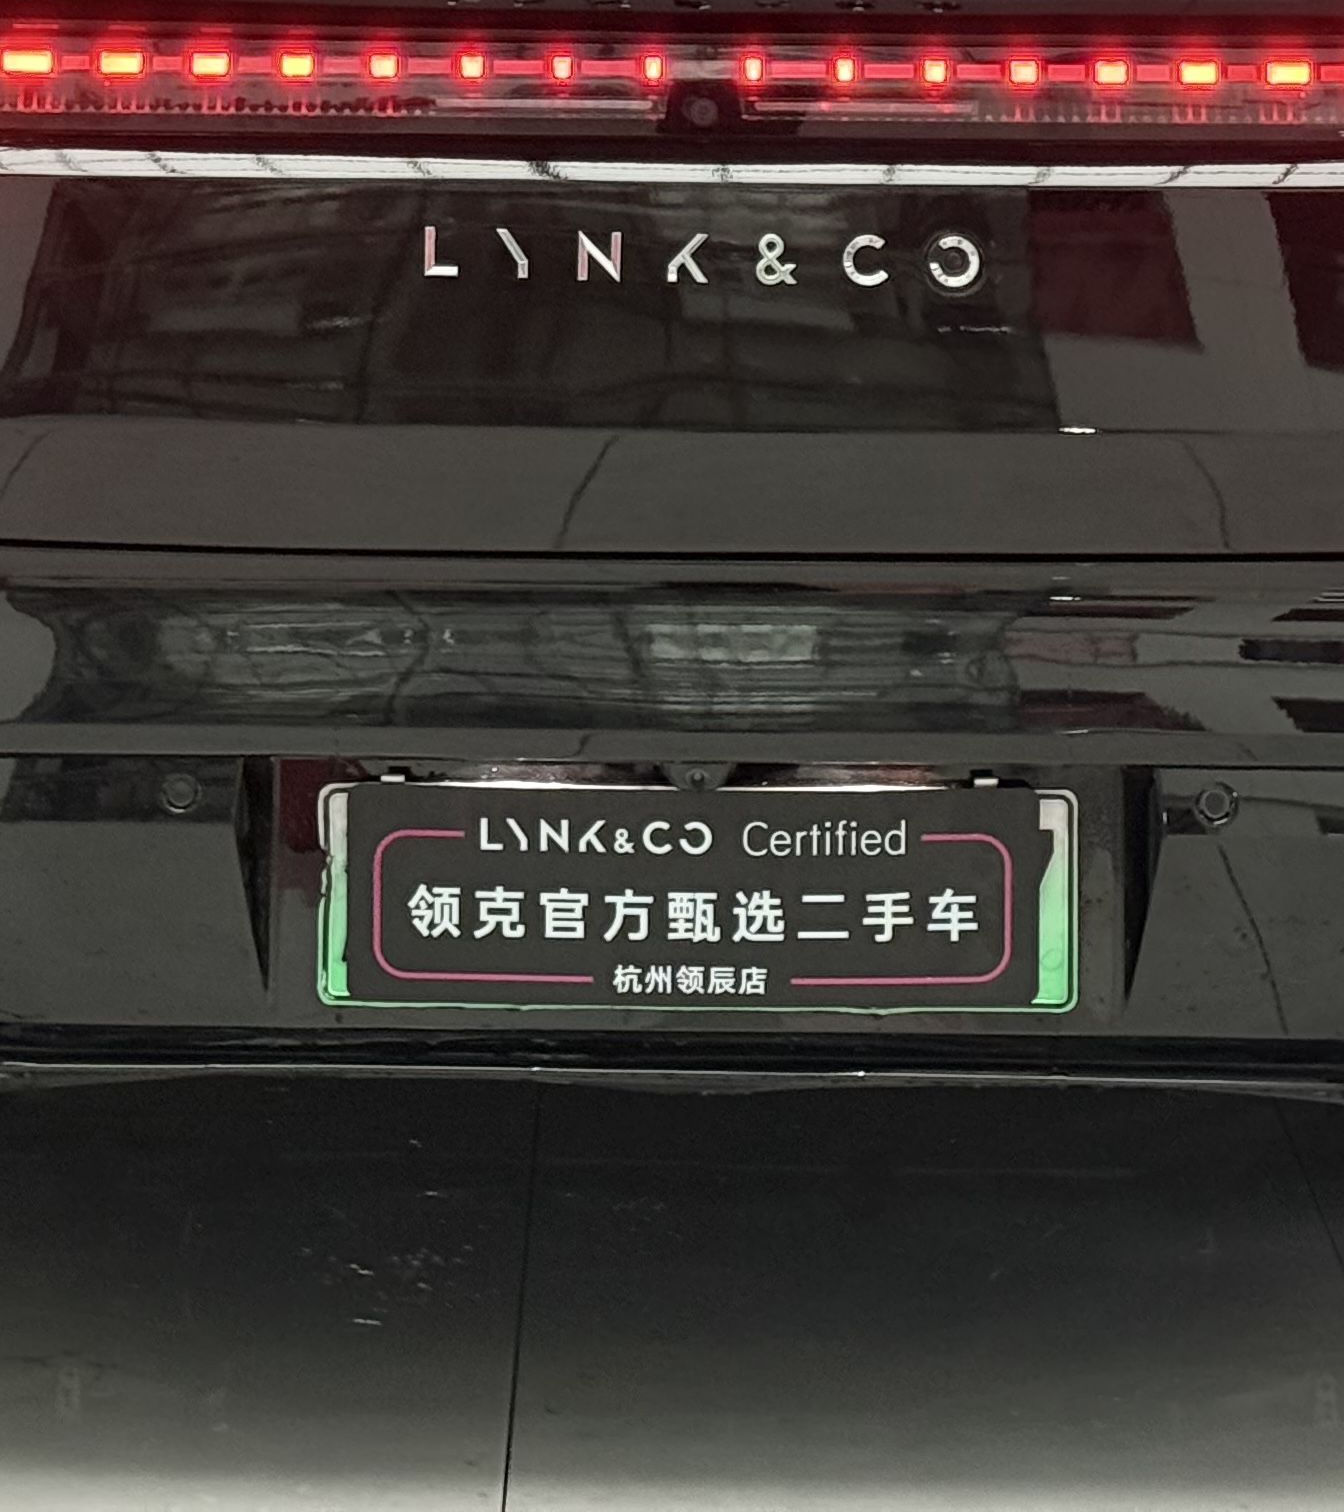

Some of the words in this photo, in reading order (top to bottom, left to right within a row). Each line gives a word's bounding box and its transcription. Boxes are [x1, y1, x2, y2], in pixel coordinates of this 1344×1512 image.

[478, 817, 714, 856] LYNK&CO
[741, 819, 908, 858] Certified
[407, 884, 981, 944] 领克官方甄选二手车
[612, 963, 768, 996] 杭州领辰店
